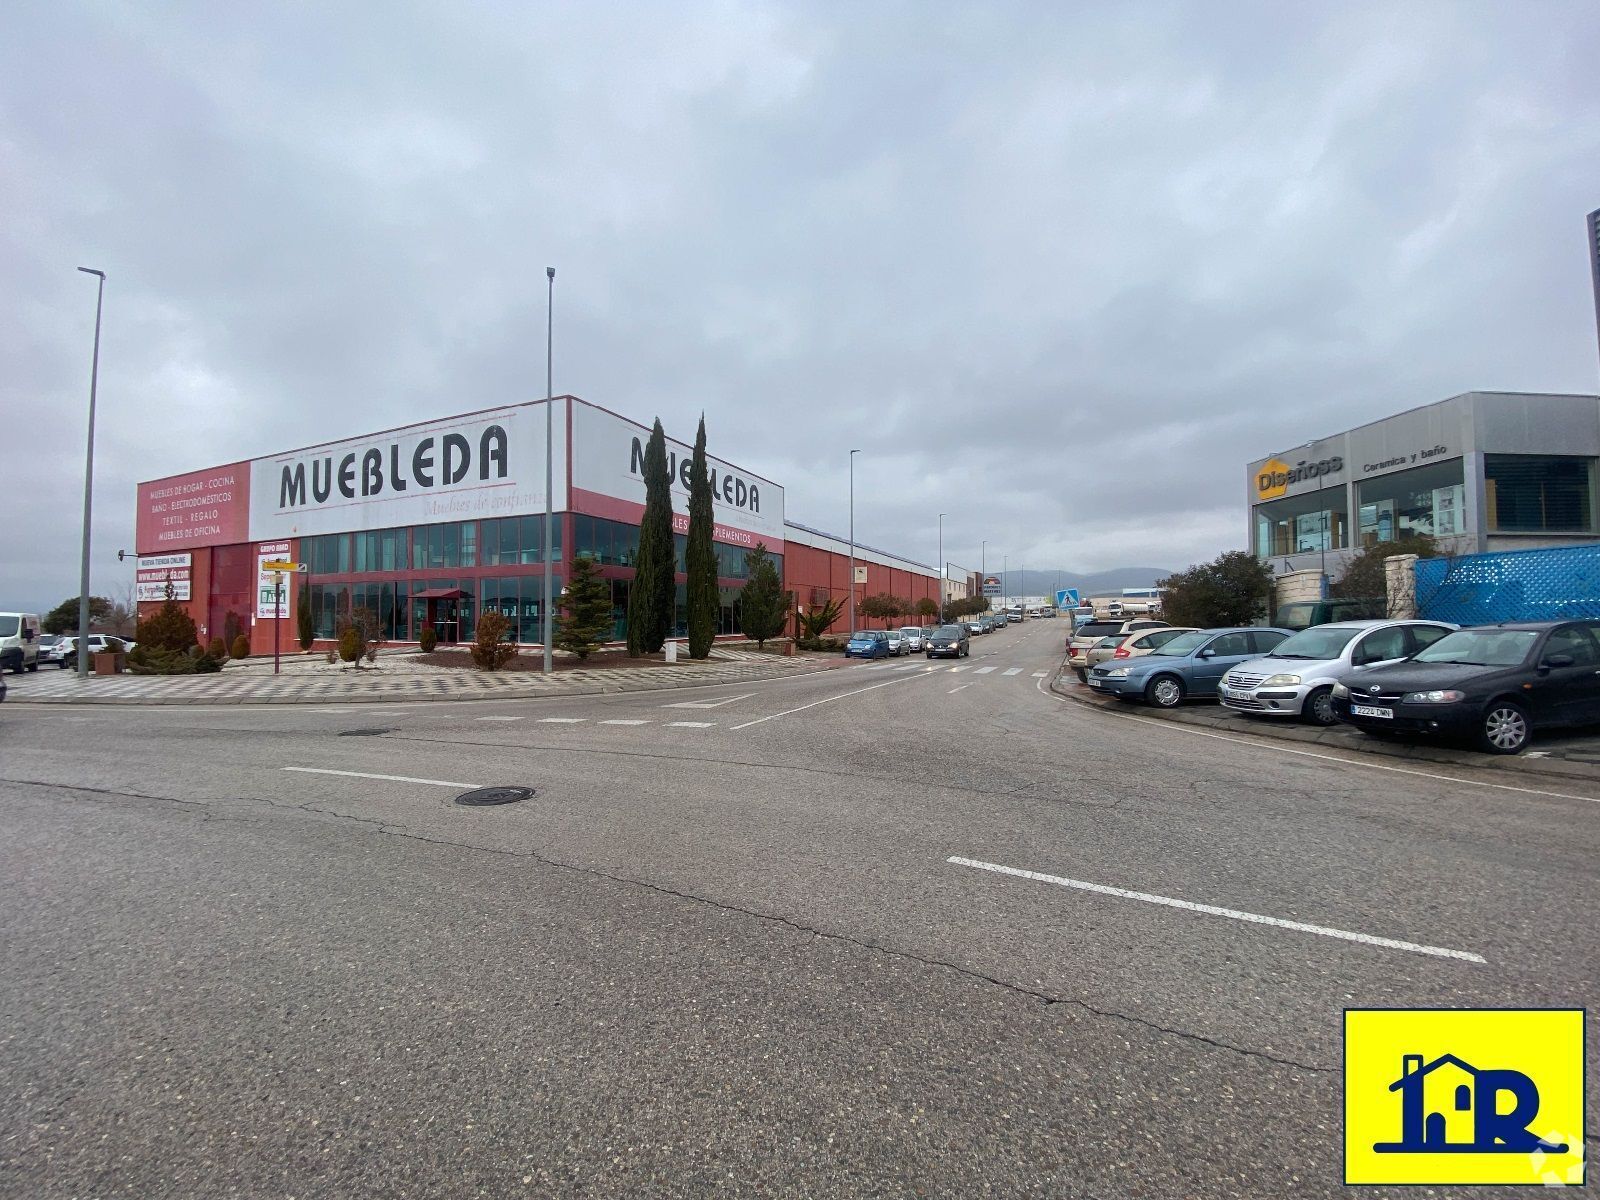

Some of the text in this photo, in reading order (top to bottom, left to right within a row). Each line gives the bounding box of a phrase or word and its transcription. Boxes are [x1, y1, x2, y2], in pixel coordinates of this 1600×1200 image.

[1410, 453, 1417, 464] y
[1421, 445, 1447, 459] baño
[279, 424, 508, 509] MUEBLEDA
[630, 436, 760, 513] MUELEDA
[1258, 456, 1344, 491] Diseñoss
[150, 488, 173, 500] MUEBLES
[174, 486, 182, 495] DE
[183, 481, 203, 494] HOGAR
[208, 475, 235, 489] COCINA
[490, 489, 546, 512] confianz
[162, 515, 183, 526] TEXTIL
[190, 509, 218, 522] REGALO
[158, 525, 221, 541] MUEBLES DE OFICINA
[138, 568, 189, 581] www.mueblda.com
[1357, 706, 1375, 715] 2224
